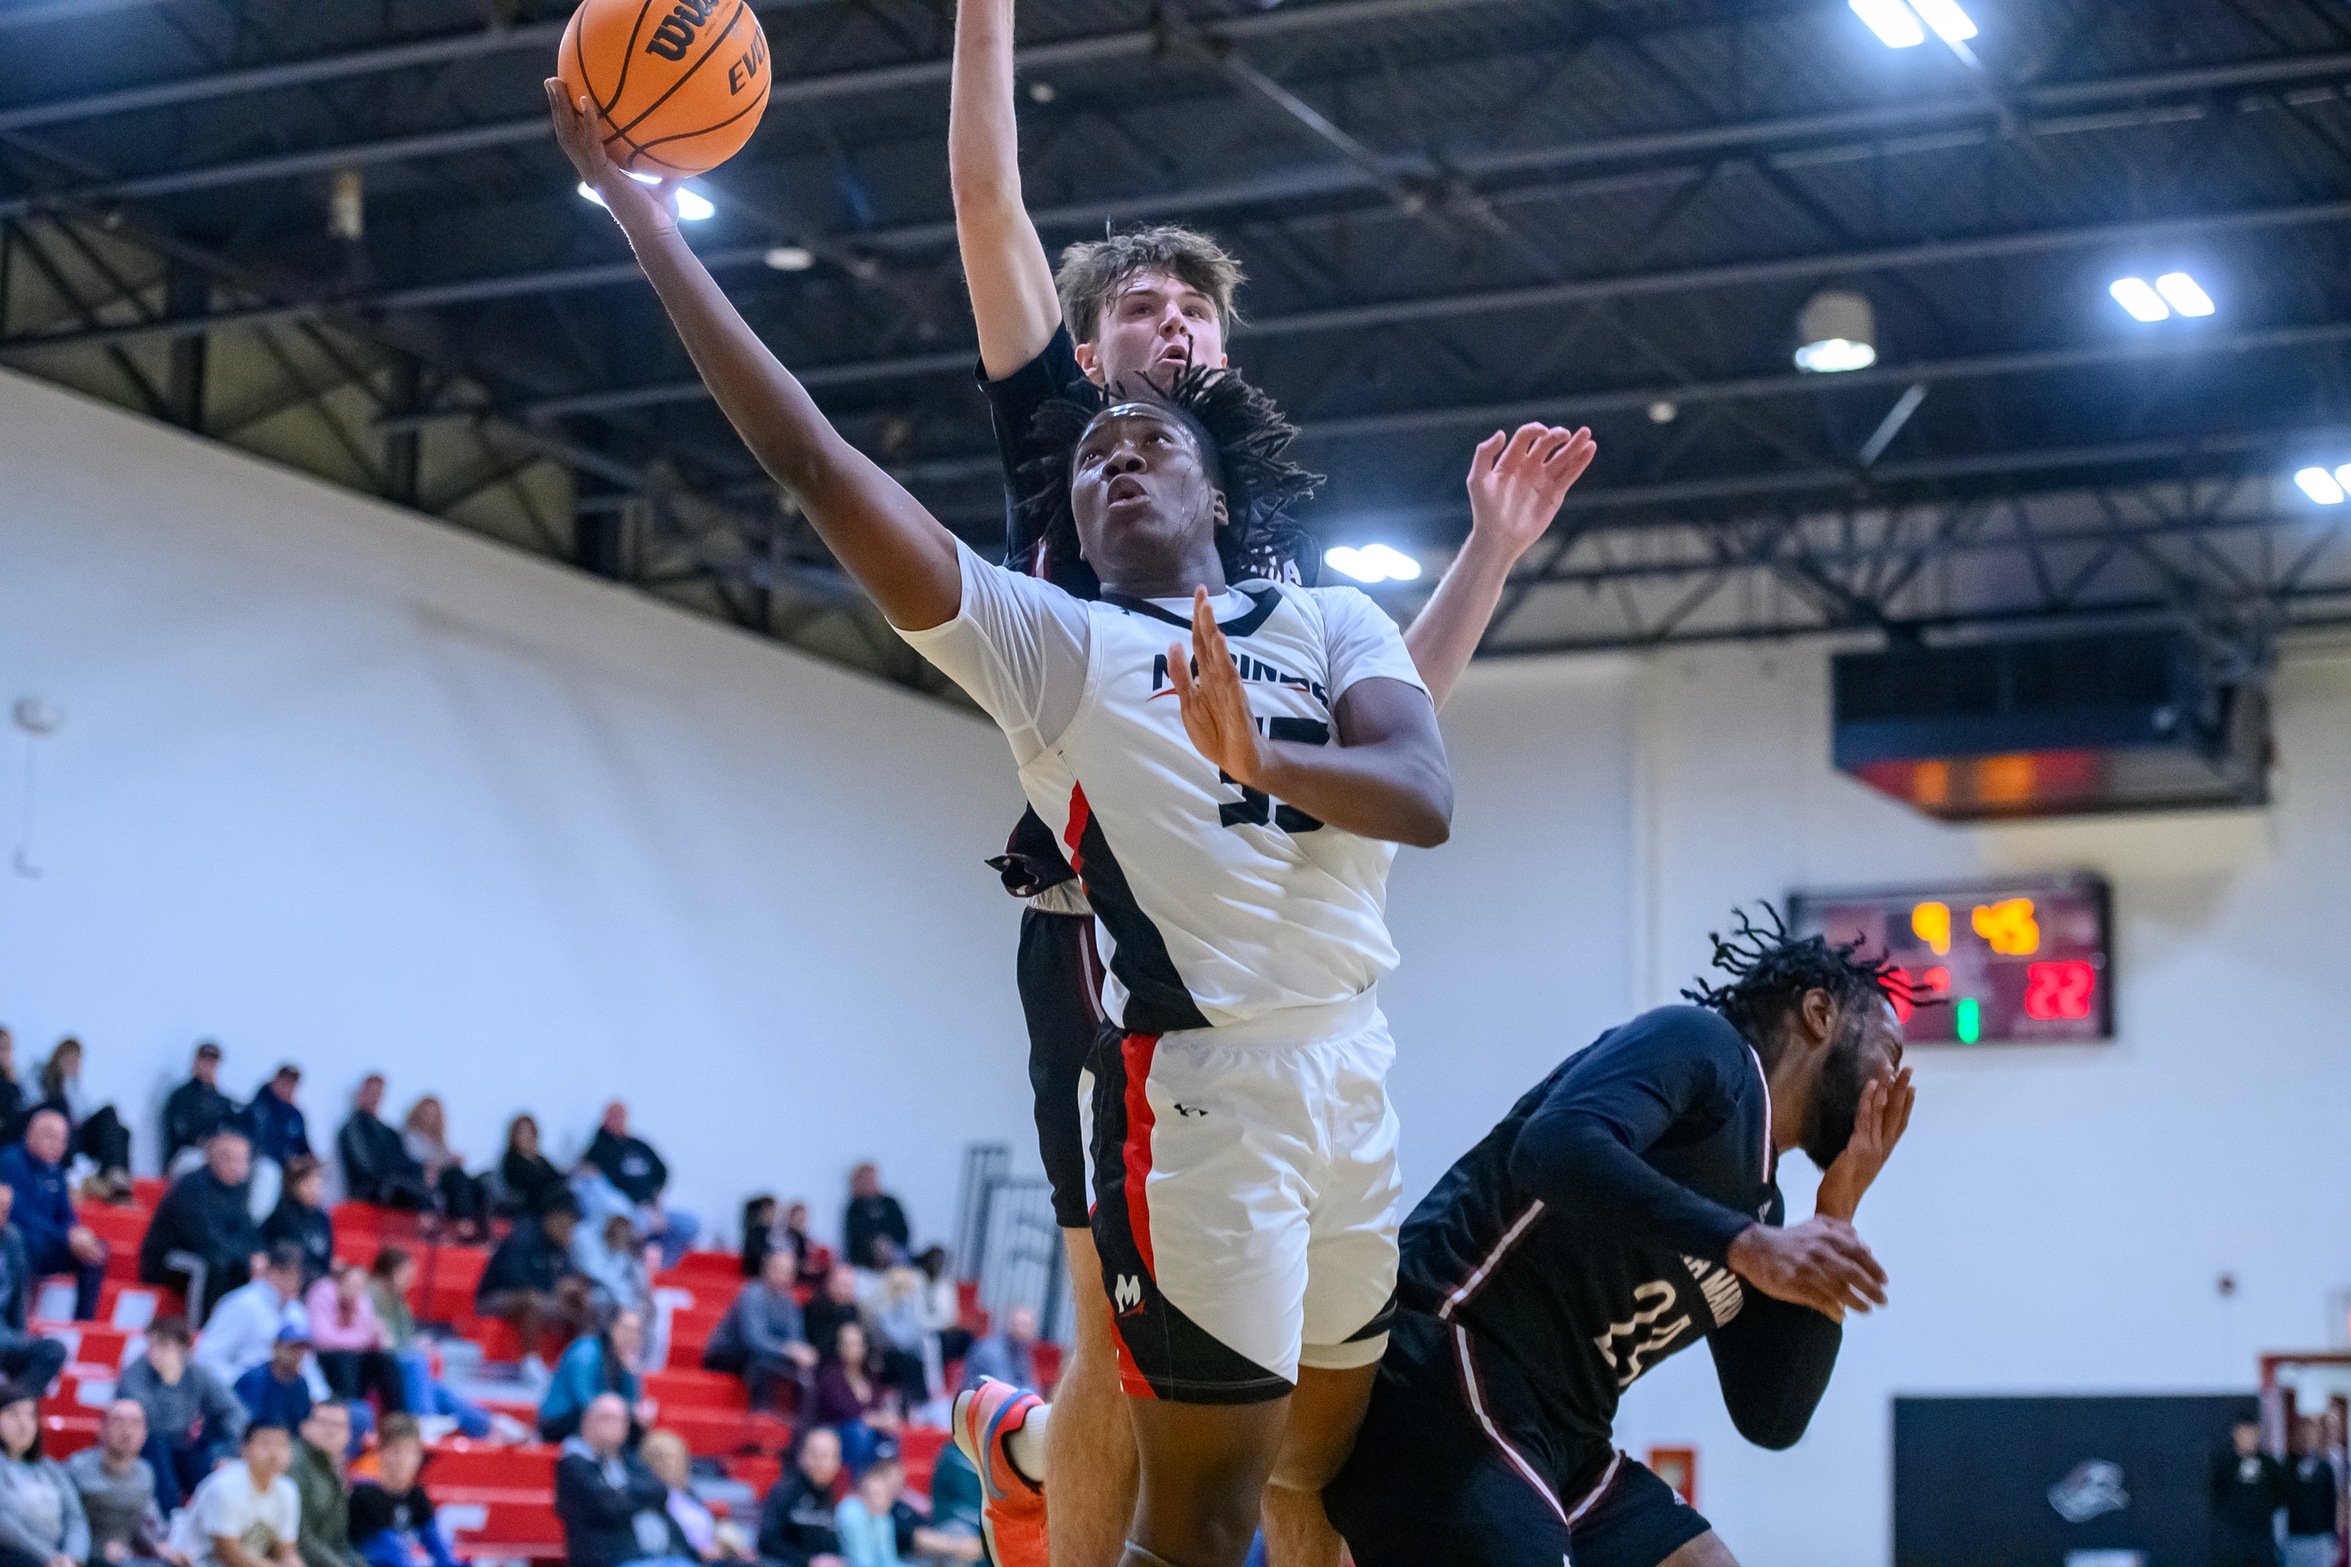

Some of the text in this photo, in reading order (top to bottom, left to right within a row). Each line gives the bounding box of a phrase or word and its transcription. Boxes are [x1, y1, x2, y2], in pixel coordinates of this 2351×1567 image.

[2025, 960, 2096, 1021] 22
[1957, 997, 1981, 1045] 1
[1114, 1272, 1142, 1315] M
